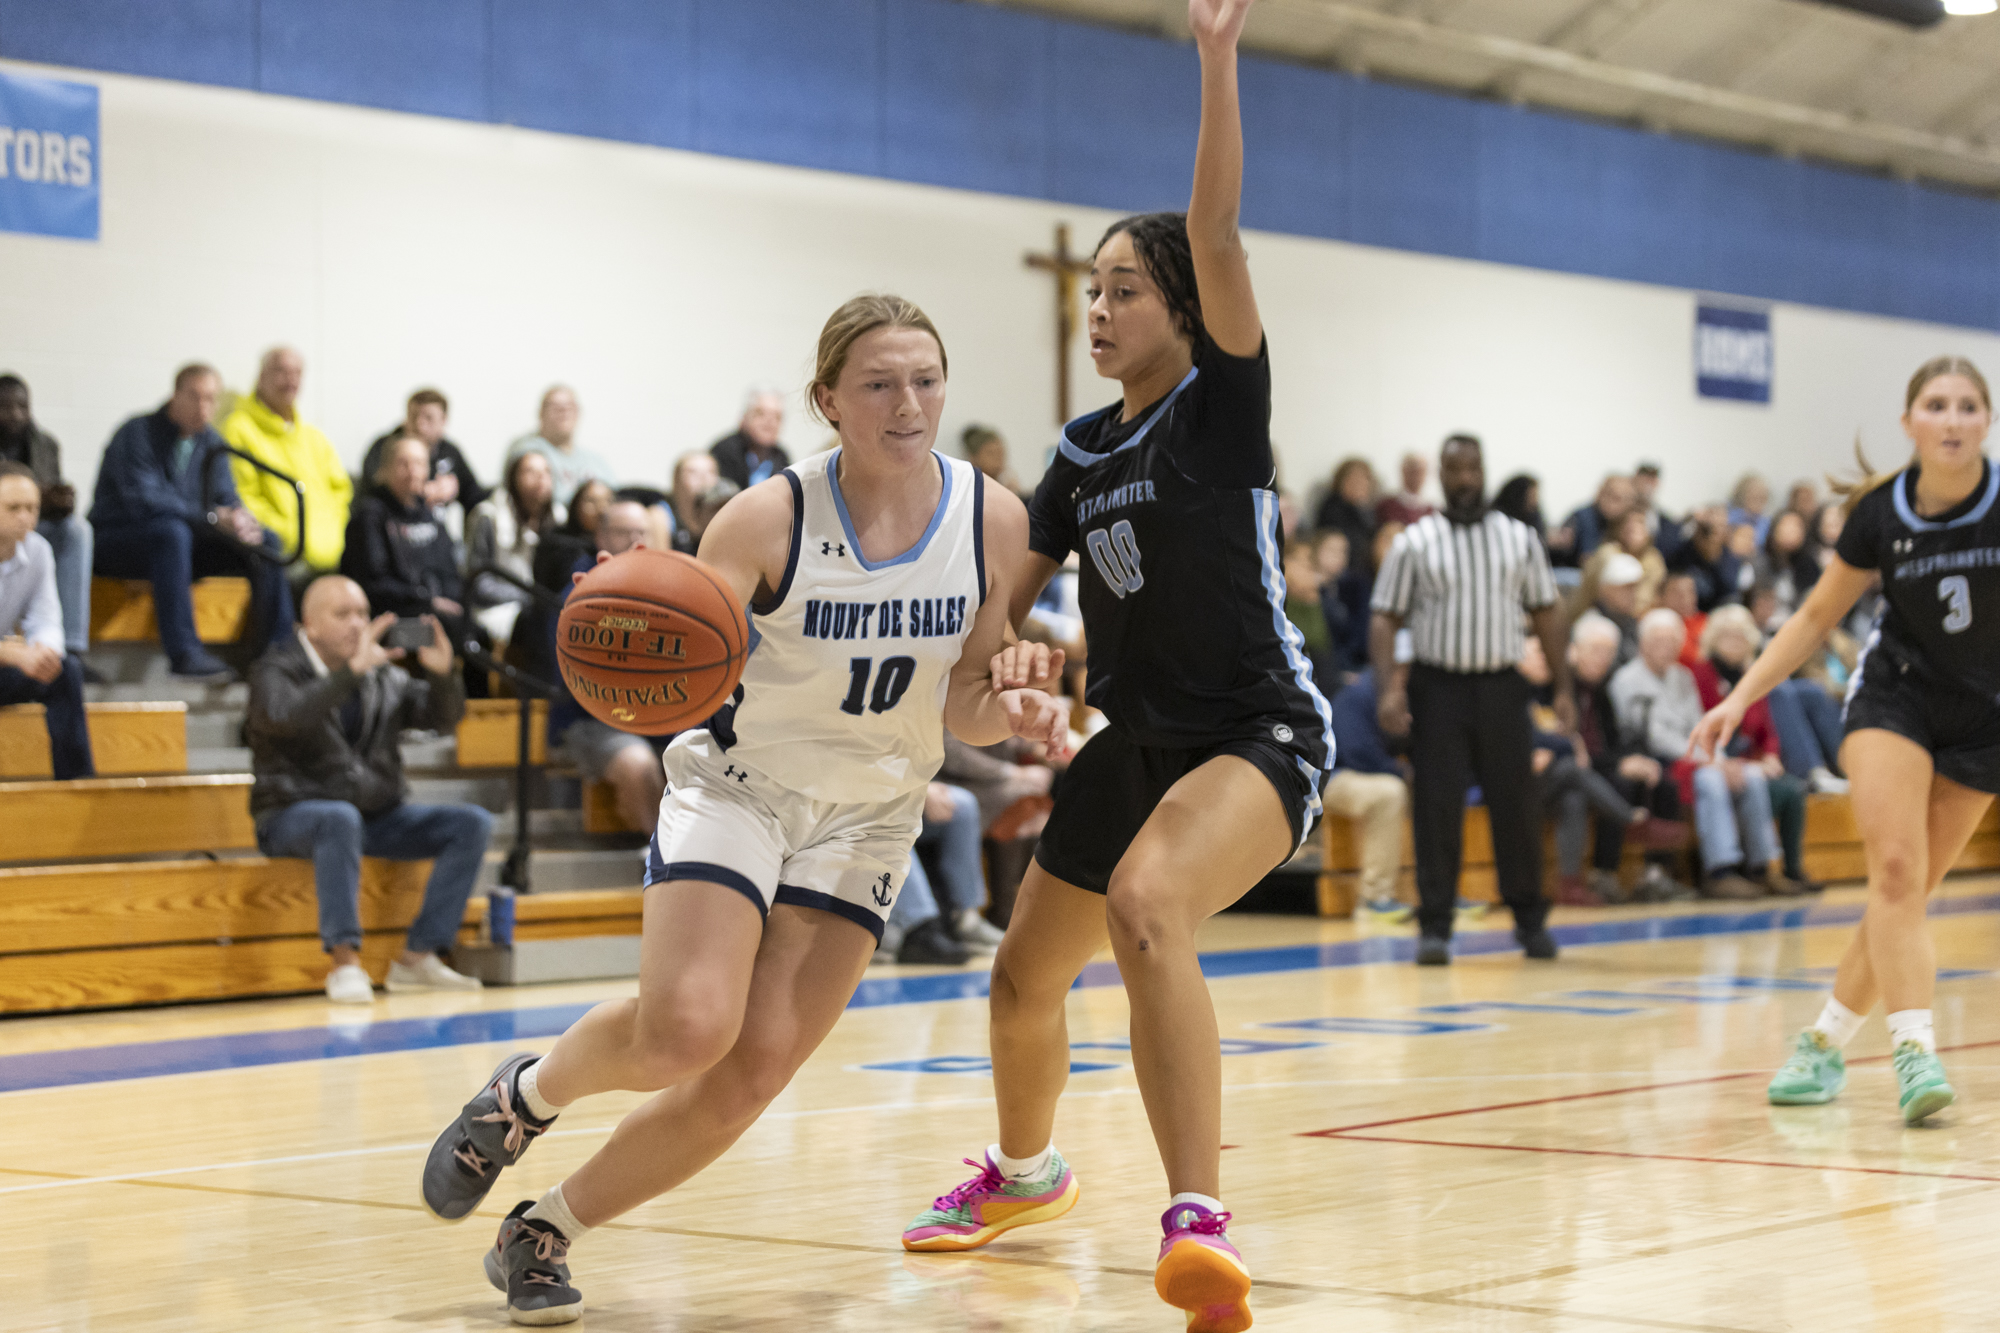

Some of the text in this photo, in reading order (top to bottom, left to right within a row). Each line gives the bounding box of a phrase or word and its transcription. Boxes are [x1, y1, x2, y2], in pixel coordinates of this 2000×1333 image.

[1087, 519, 1144, 600] 00
[803, 595, 967, 640] MOUNT DE SALES
[1938, 574, 1973, 635] 3
[564, 663, 690, 706] SPALDING
[839, 655, 917, 716] 10
